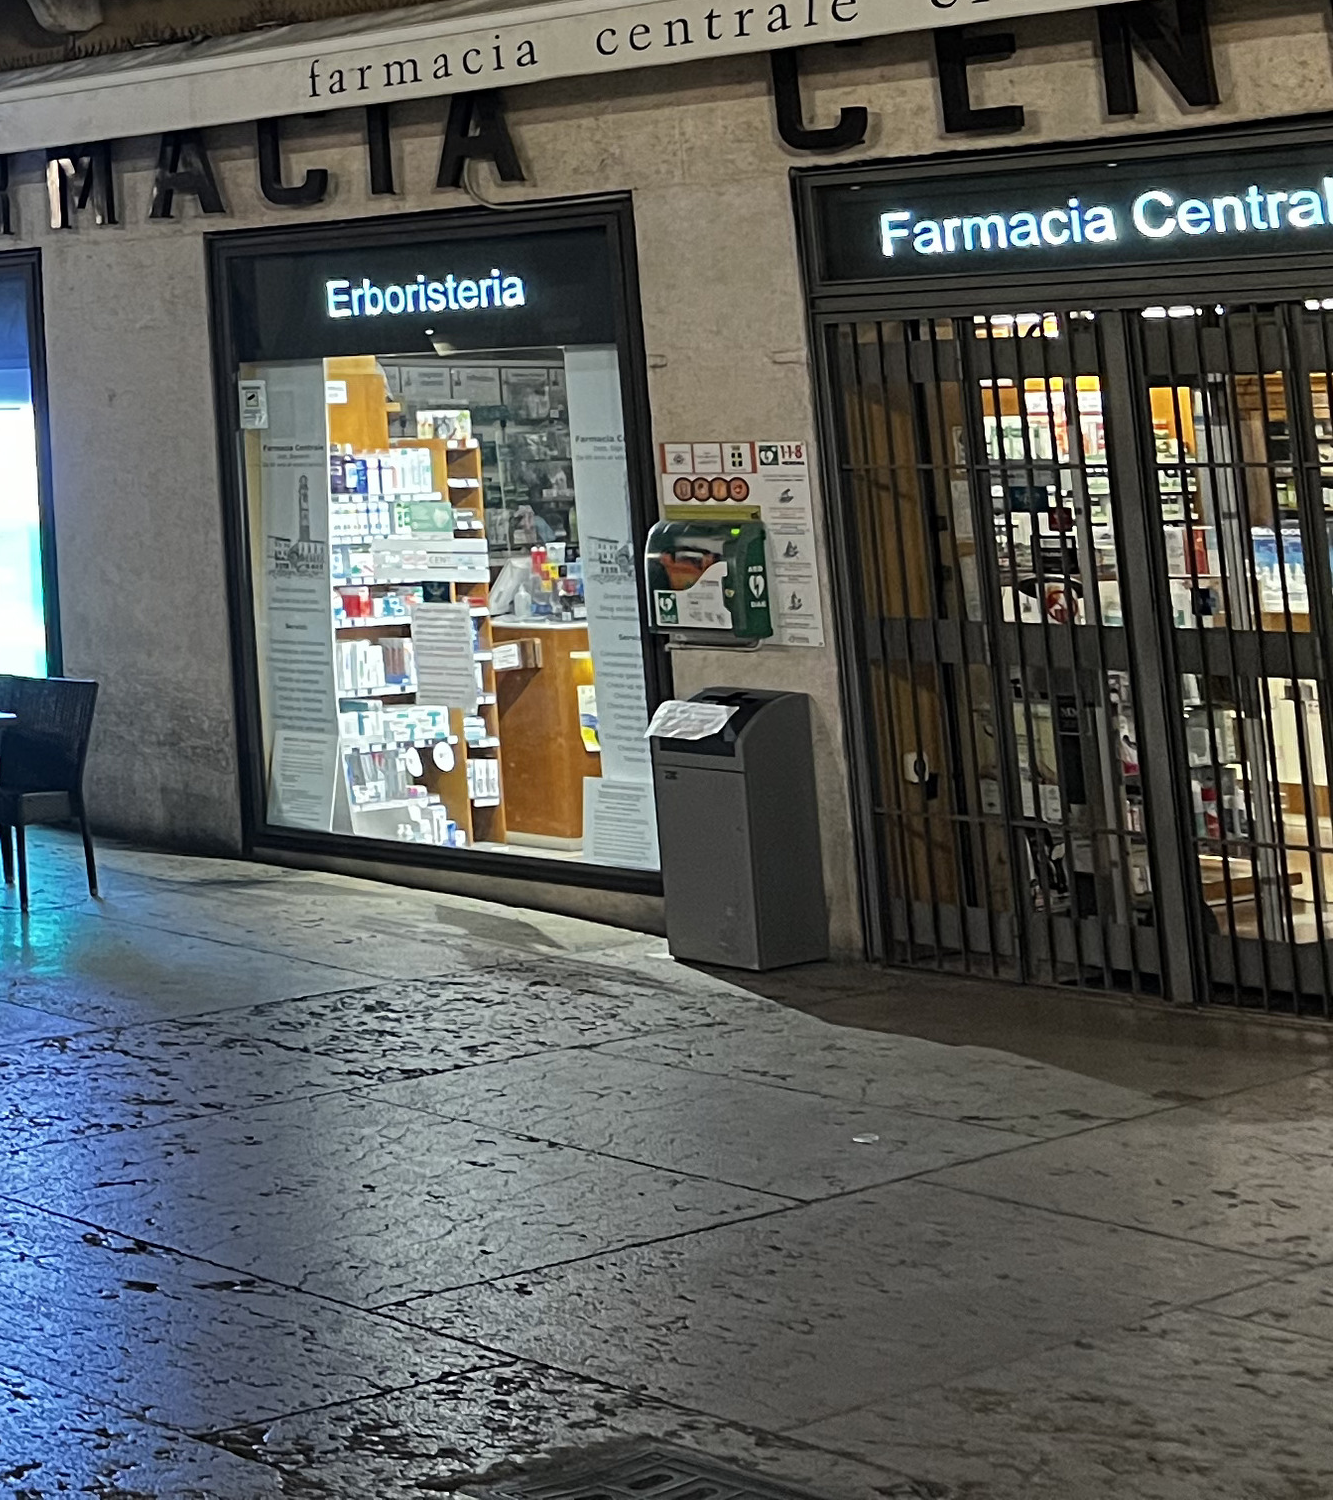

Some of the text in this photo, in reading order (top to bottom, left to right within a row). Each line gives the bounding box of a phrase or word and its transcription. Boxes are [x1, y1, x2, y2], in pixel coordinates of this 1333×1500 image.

[308, 34, 538, 98] farmacia
[879, 176, 1333, 257] Farmacia Central
[326, 268, 526, 318] Erboristeria
